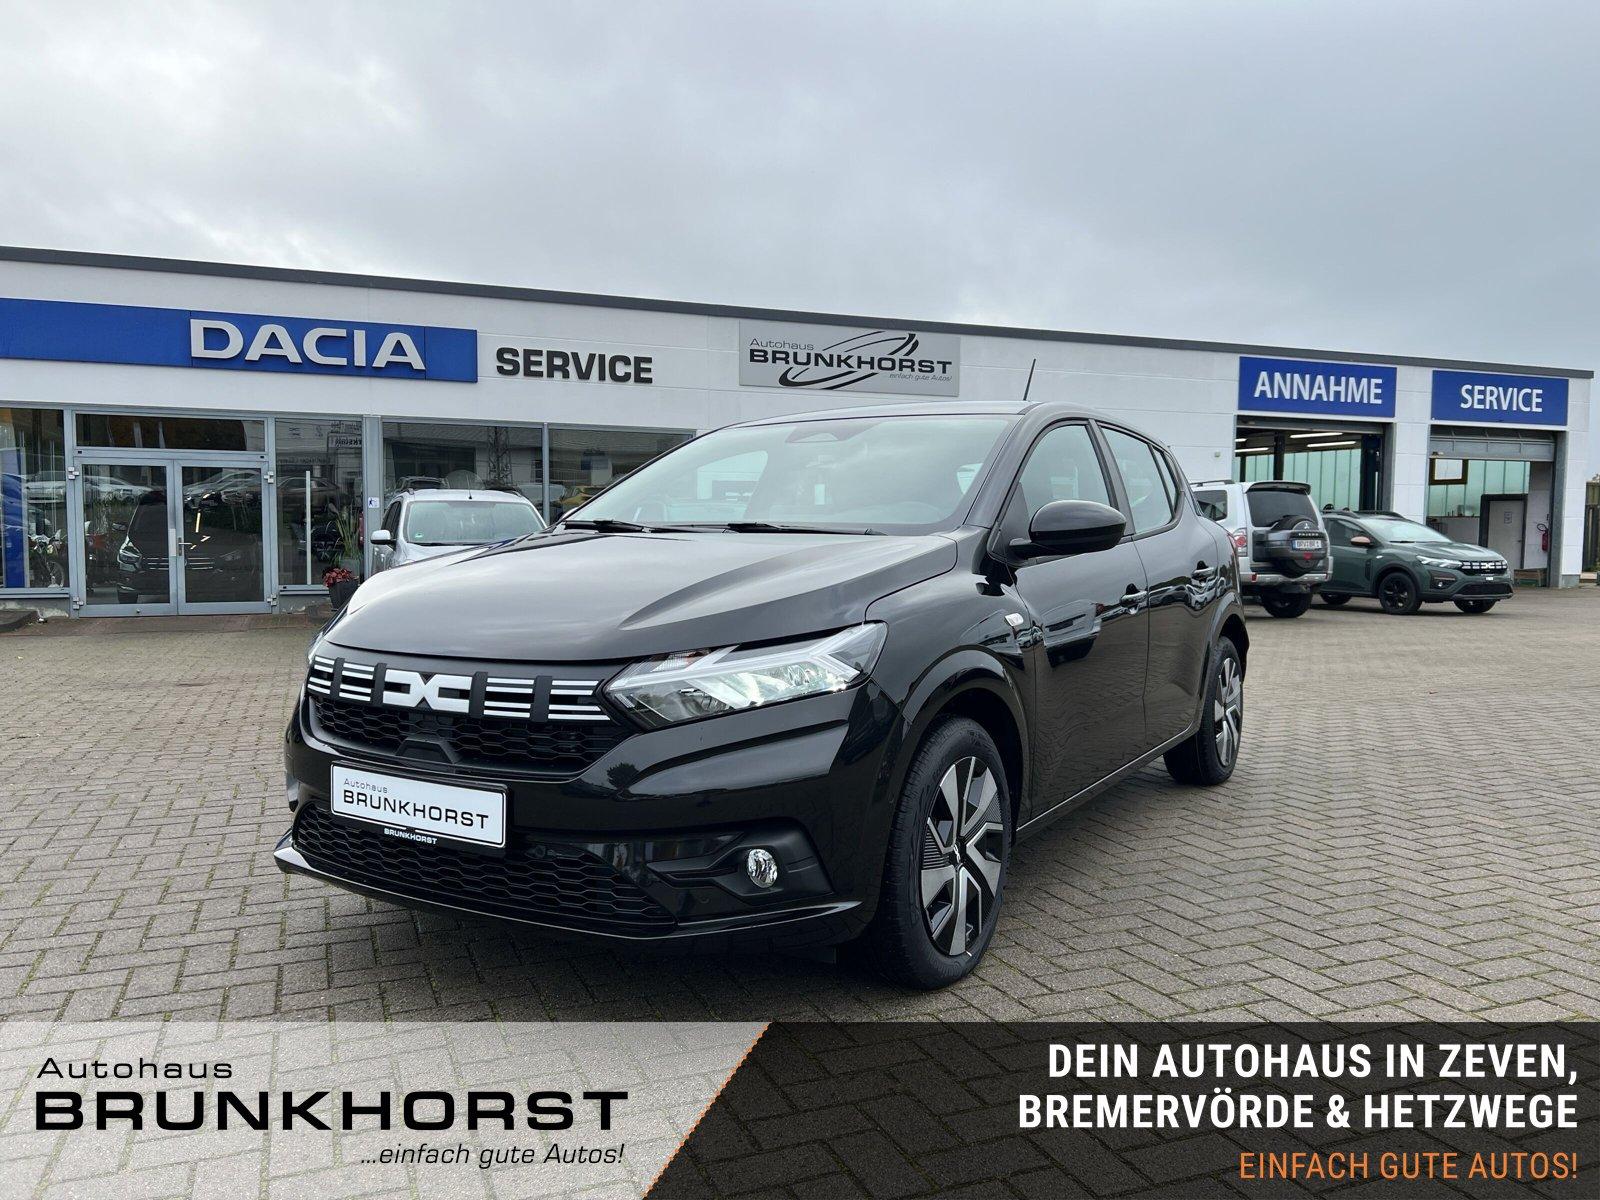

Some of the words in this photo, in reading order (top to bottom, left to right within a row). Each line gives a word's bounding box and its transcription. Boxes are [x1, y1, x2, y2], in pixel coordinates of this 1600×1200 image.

[189, 318, 426, 370] DACIA
[749, 338, 815, 351] Autohaus
[496, 347, 653, 384] SERVICE
[749, 348, 953, 375] BRUNKHORST
[1254, 370, 1383, 405] ANNAHME
[1460, 384, 1543, 413] SERVICE
[343, 778, 388, 794] Autohaus
[343, 789, 490, 829] BRUNKHORST
[383, 827, 438, 845] BRUNKHORST
